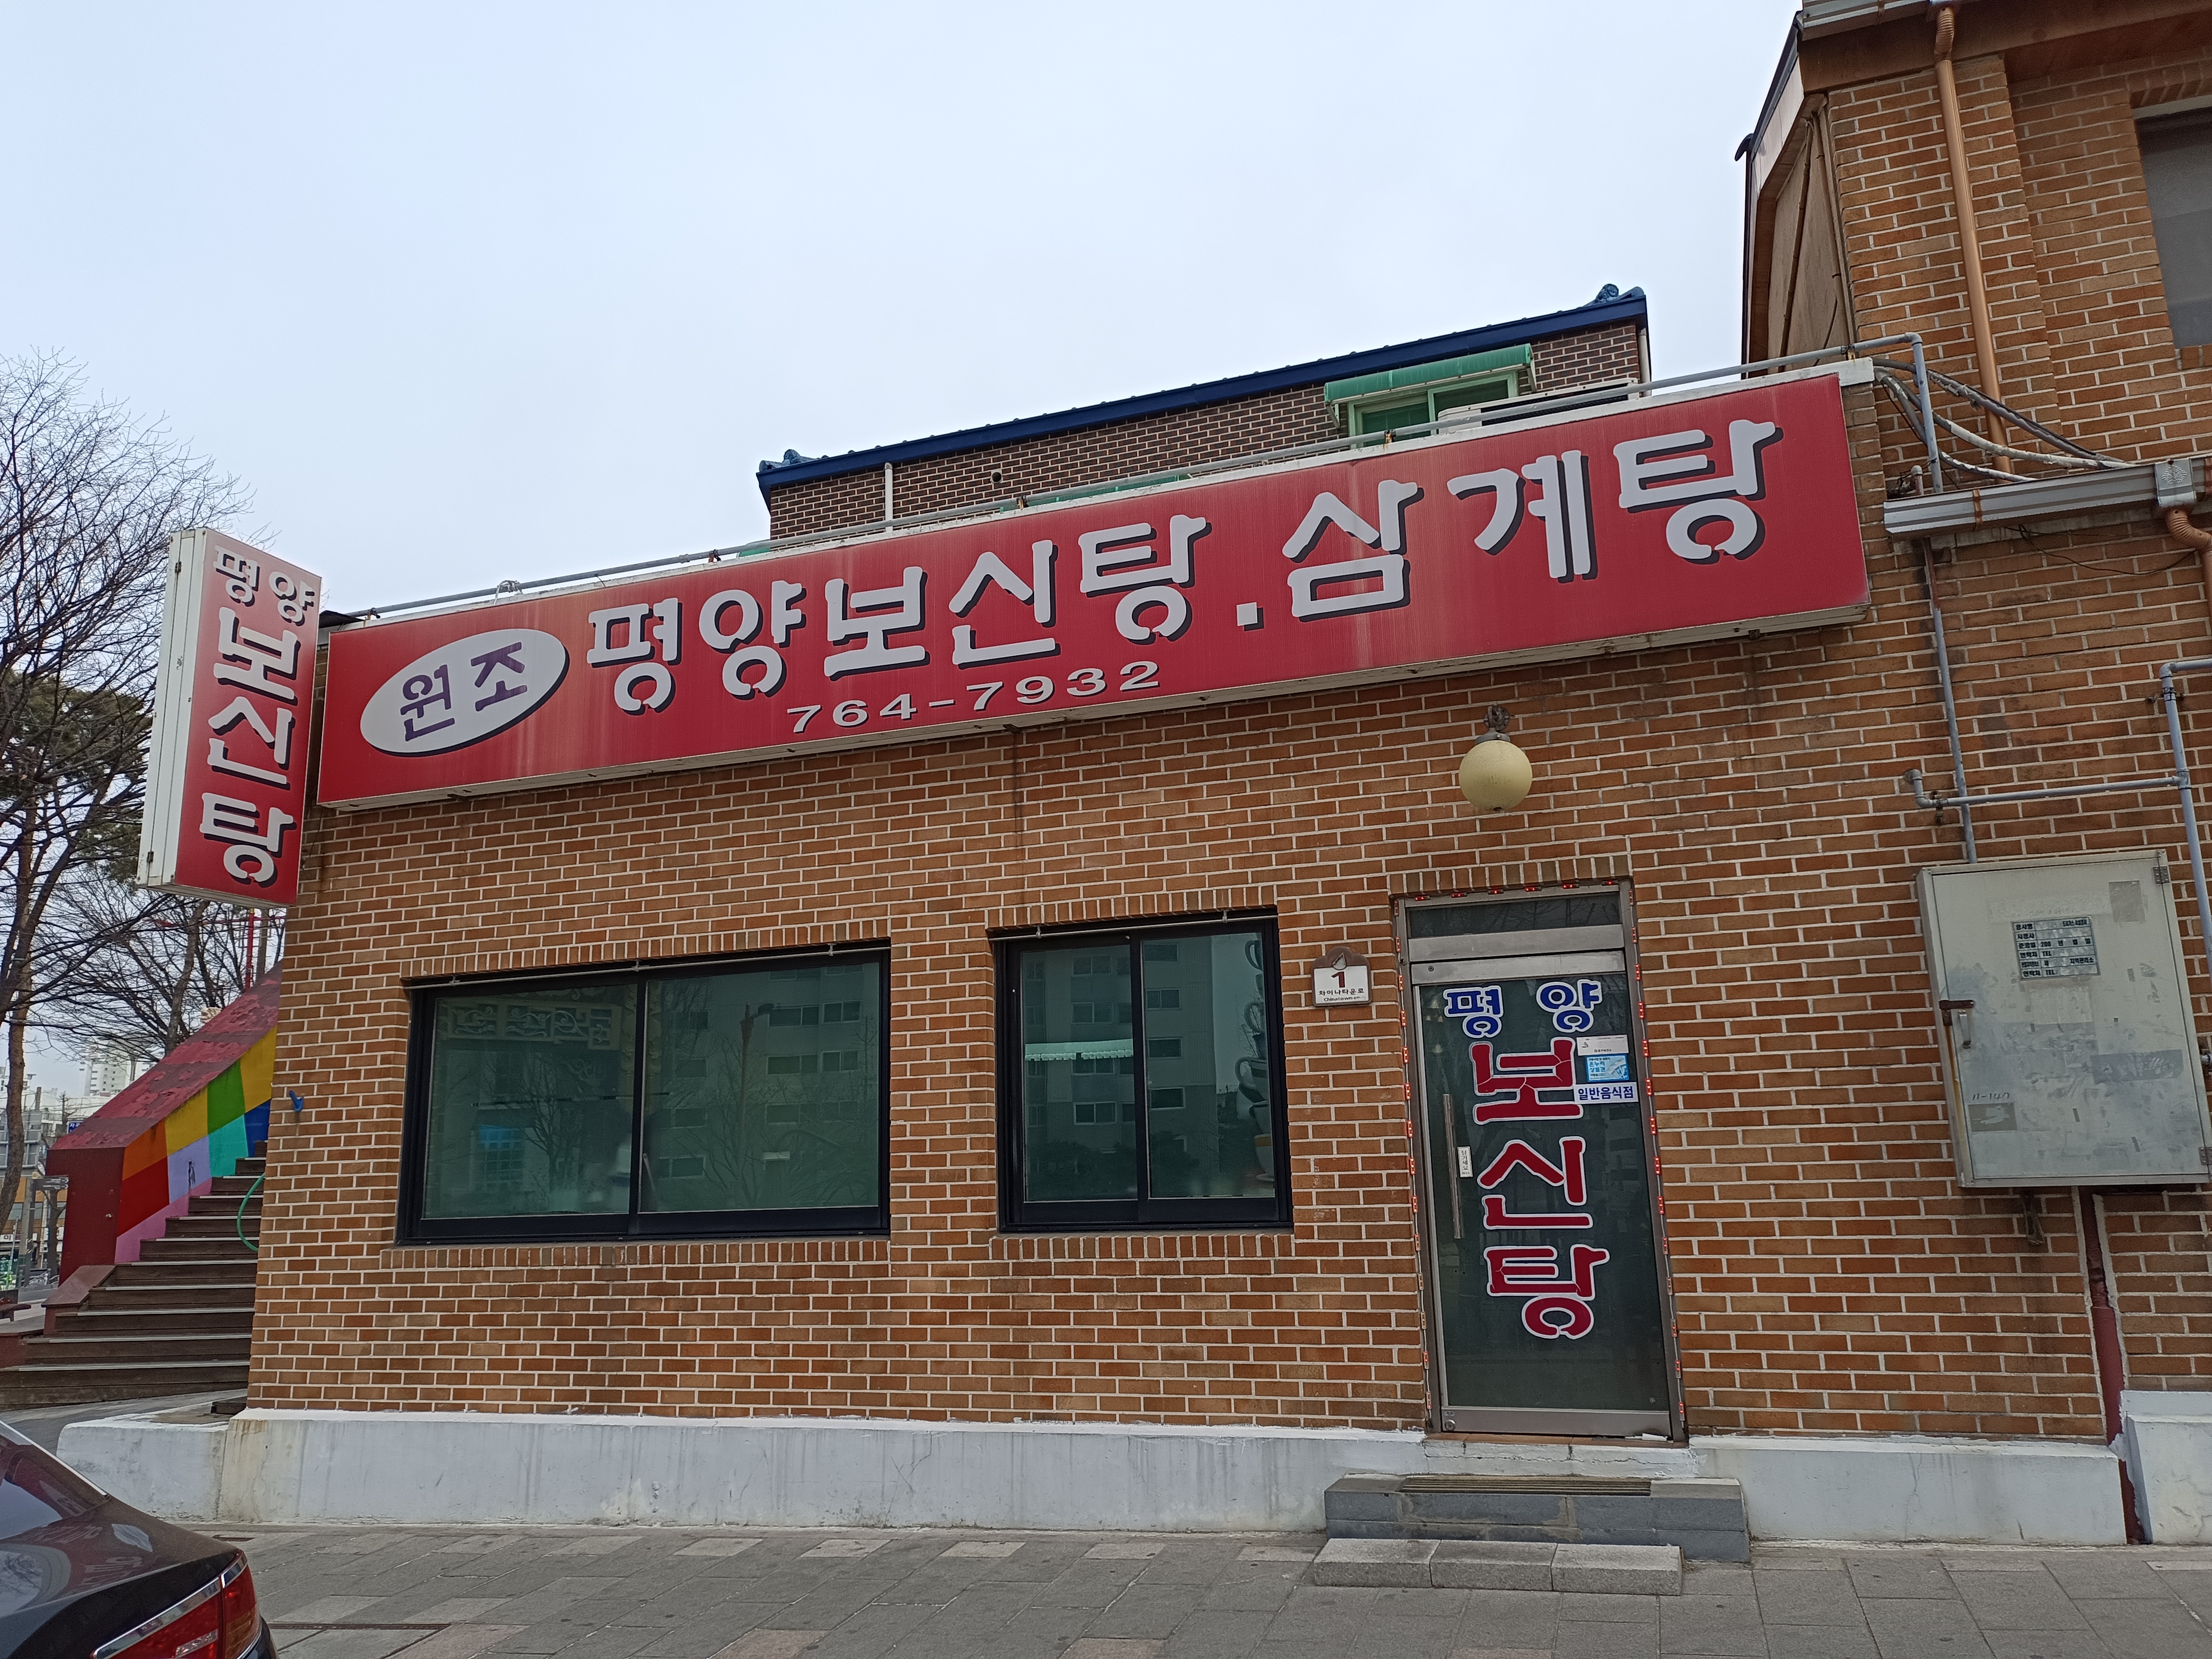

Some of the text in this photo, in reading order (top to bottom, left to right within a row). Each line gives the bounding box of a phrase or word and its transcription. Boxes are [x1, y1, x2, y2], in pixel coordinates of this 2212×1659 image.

[213, 545, 315, 625] 평양
[400, 641, 528, 742] 원조
[786, 661, 1160, 734] 764-7932
[199, 607, 300, 887] 보신탕
[1319, 988, 1365, 996] 차이나타운로
[1331, 971, 1346, 988] 1
[1444, 979, 1602, 1038] 평양
[1578, 1085, 1634, 1101] 일반음식점
[1469, 1037, 1610, 1339] 보신탕
